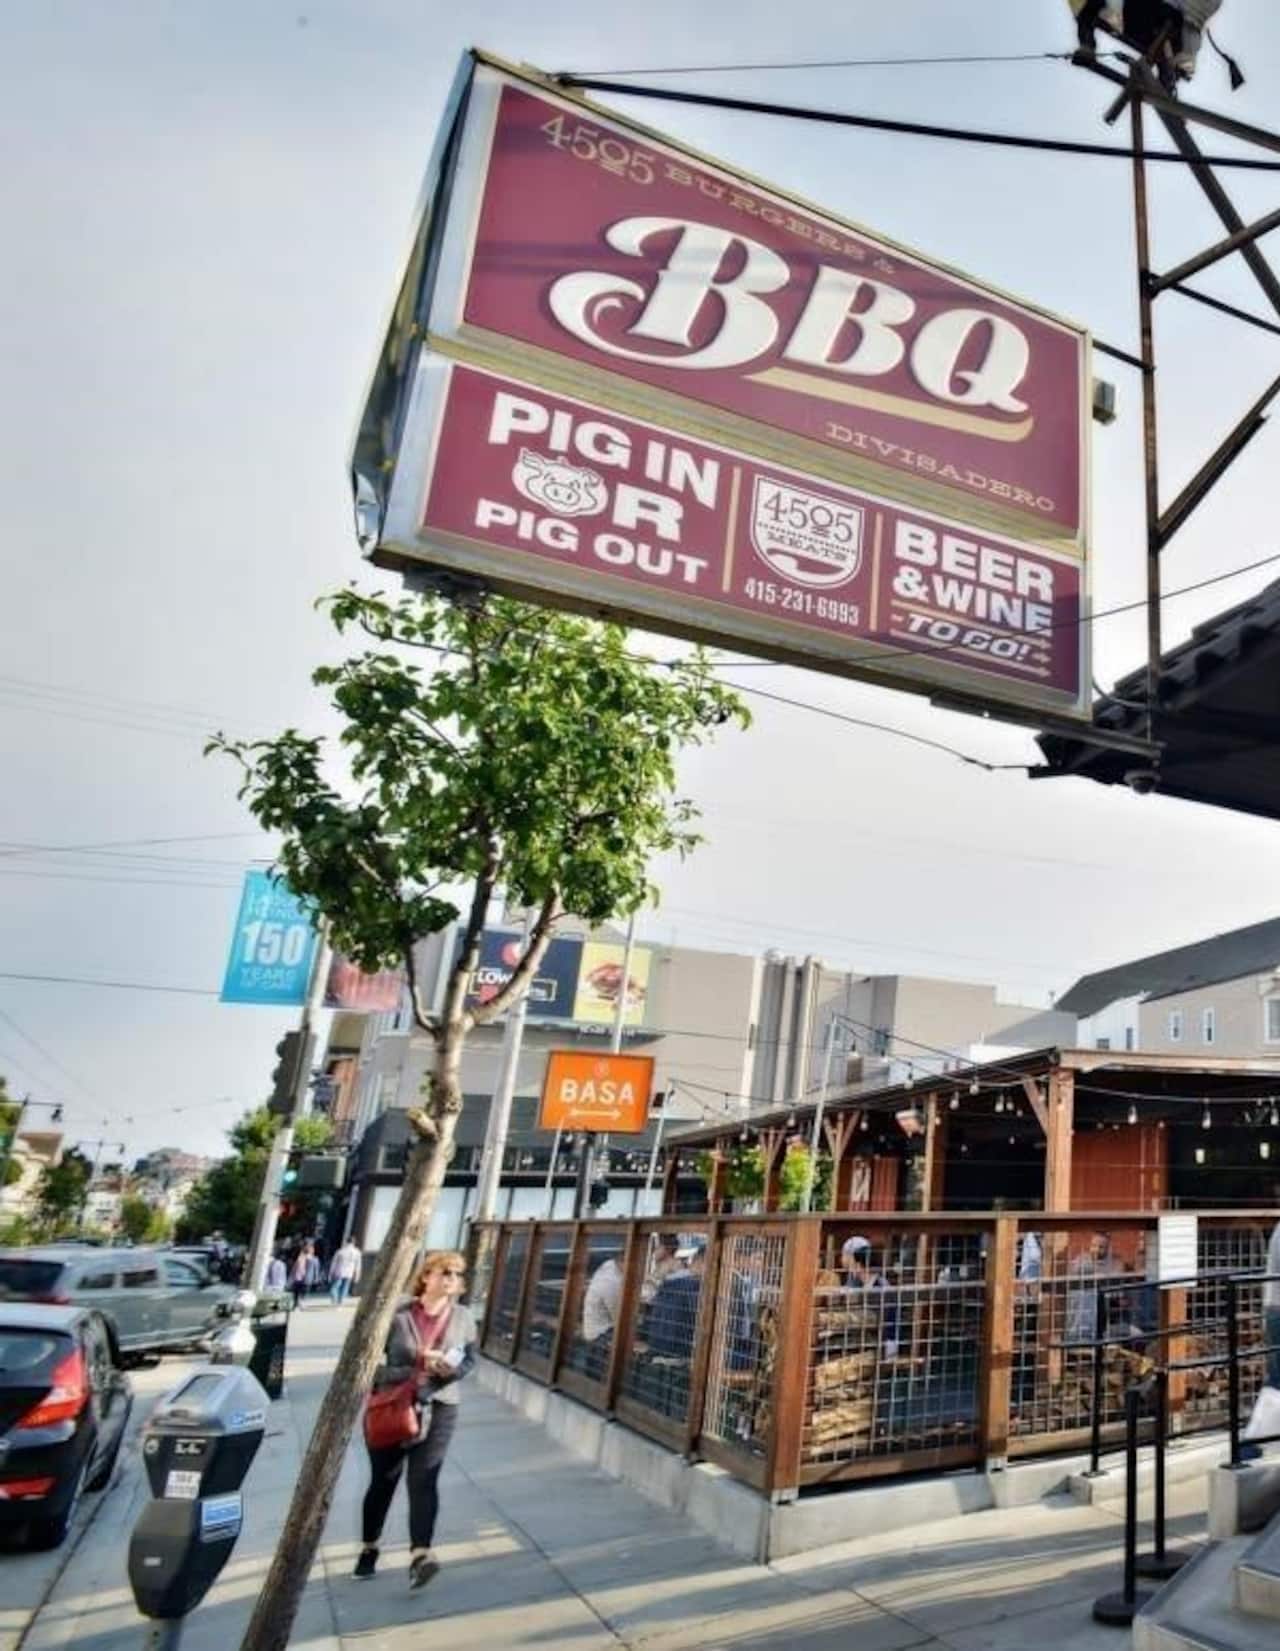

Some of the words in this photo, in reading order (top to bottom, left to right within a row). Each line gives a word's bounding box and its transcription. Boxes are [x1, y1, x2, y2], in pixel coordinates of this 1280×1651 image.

[665, 162, 866, 262] BURGERS
[872, 258, 896, 275] &
[549, 216, 1029, 413] BBQ
[488, 391, 632, 470] PIG
[645, 439, 720, 510] IN
[826, 422, 1056, 512] DIVISADERO
[475, 498, 580, 552] PIG
[593, 533, 709, 584] OUT
[767, 531, 848, 561] MEATS
[894, 519, 1054, 603] BEER
[744, 578, 859, 627] 415-231-6993
[907, 612, 959, 642] TO
[242, 920, 307, 967] 150
[560, 1077, 636, 1106] BASA
